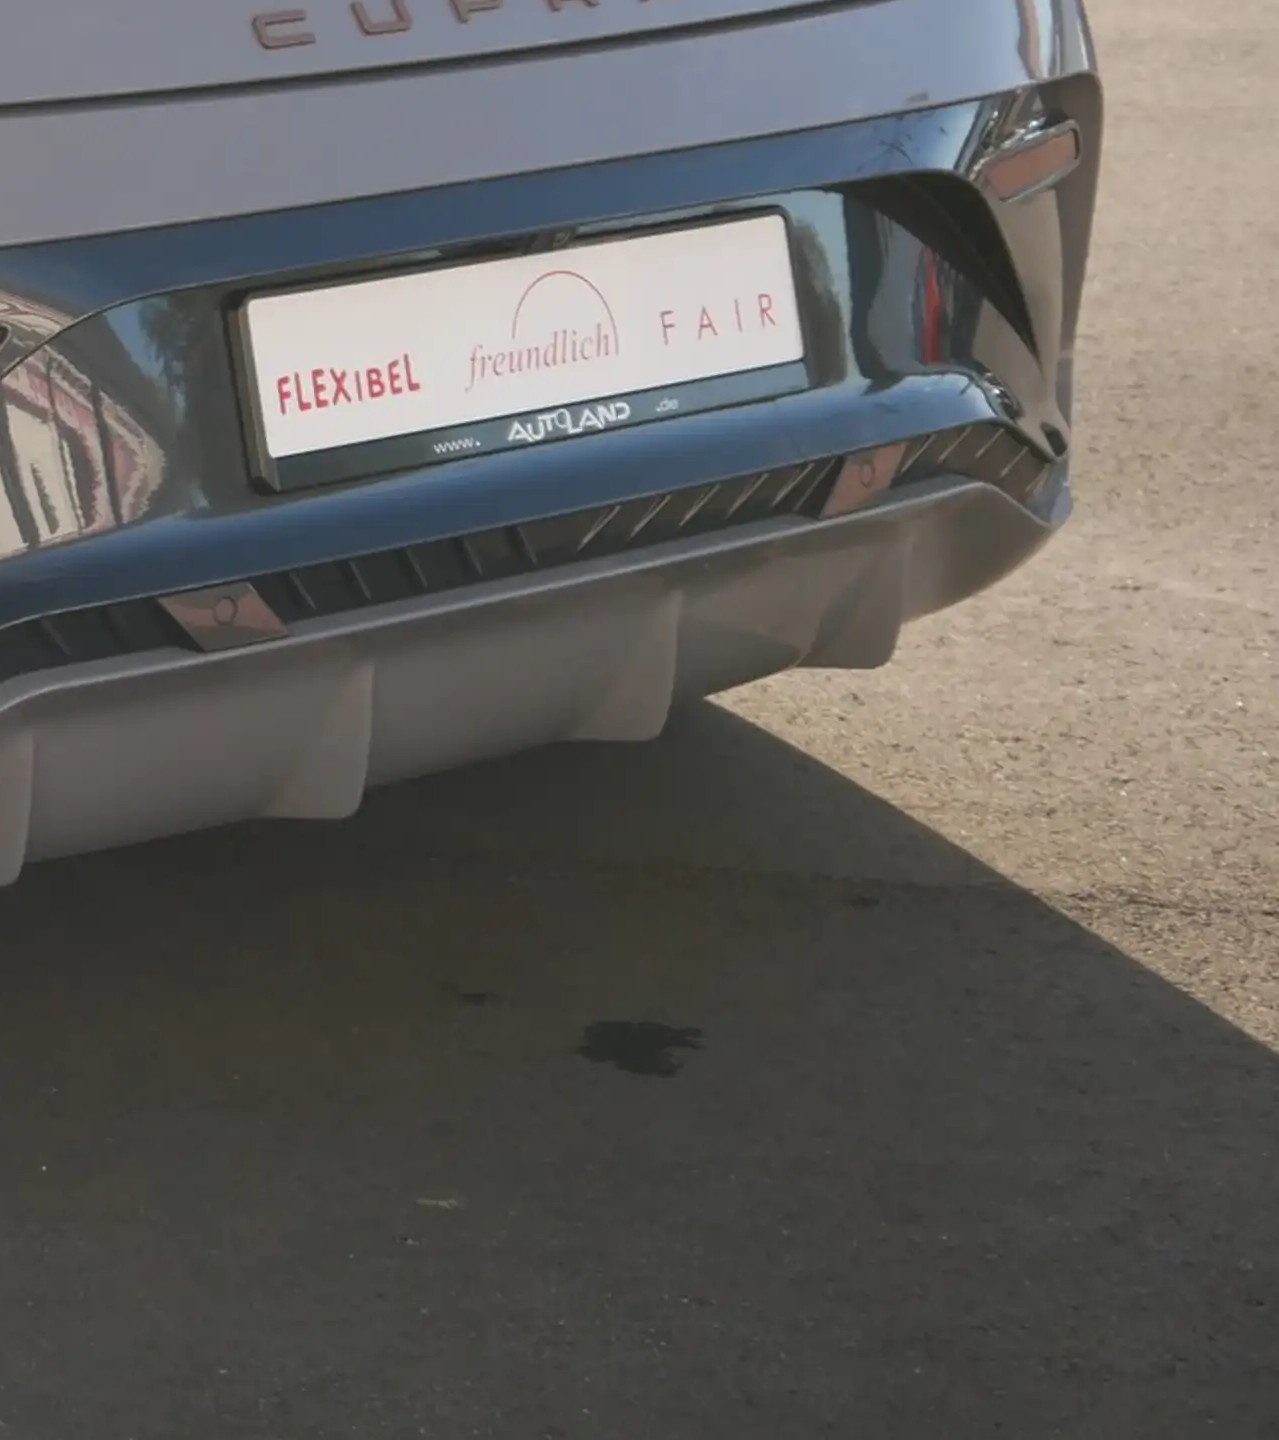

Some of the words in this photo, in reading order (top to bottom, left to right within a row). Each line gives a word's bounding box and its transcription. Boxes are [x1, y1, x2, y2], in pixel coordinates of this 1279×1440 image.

[276, 352, 421, 414] FLEXIBEL
[463, 322, 610, 392] freundlich
[659, 292, 776, 346] FAIR
[433, 436, 481, 455] www.
[506, 402, 631, 443] AUTOLAND
